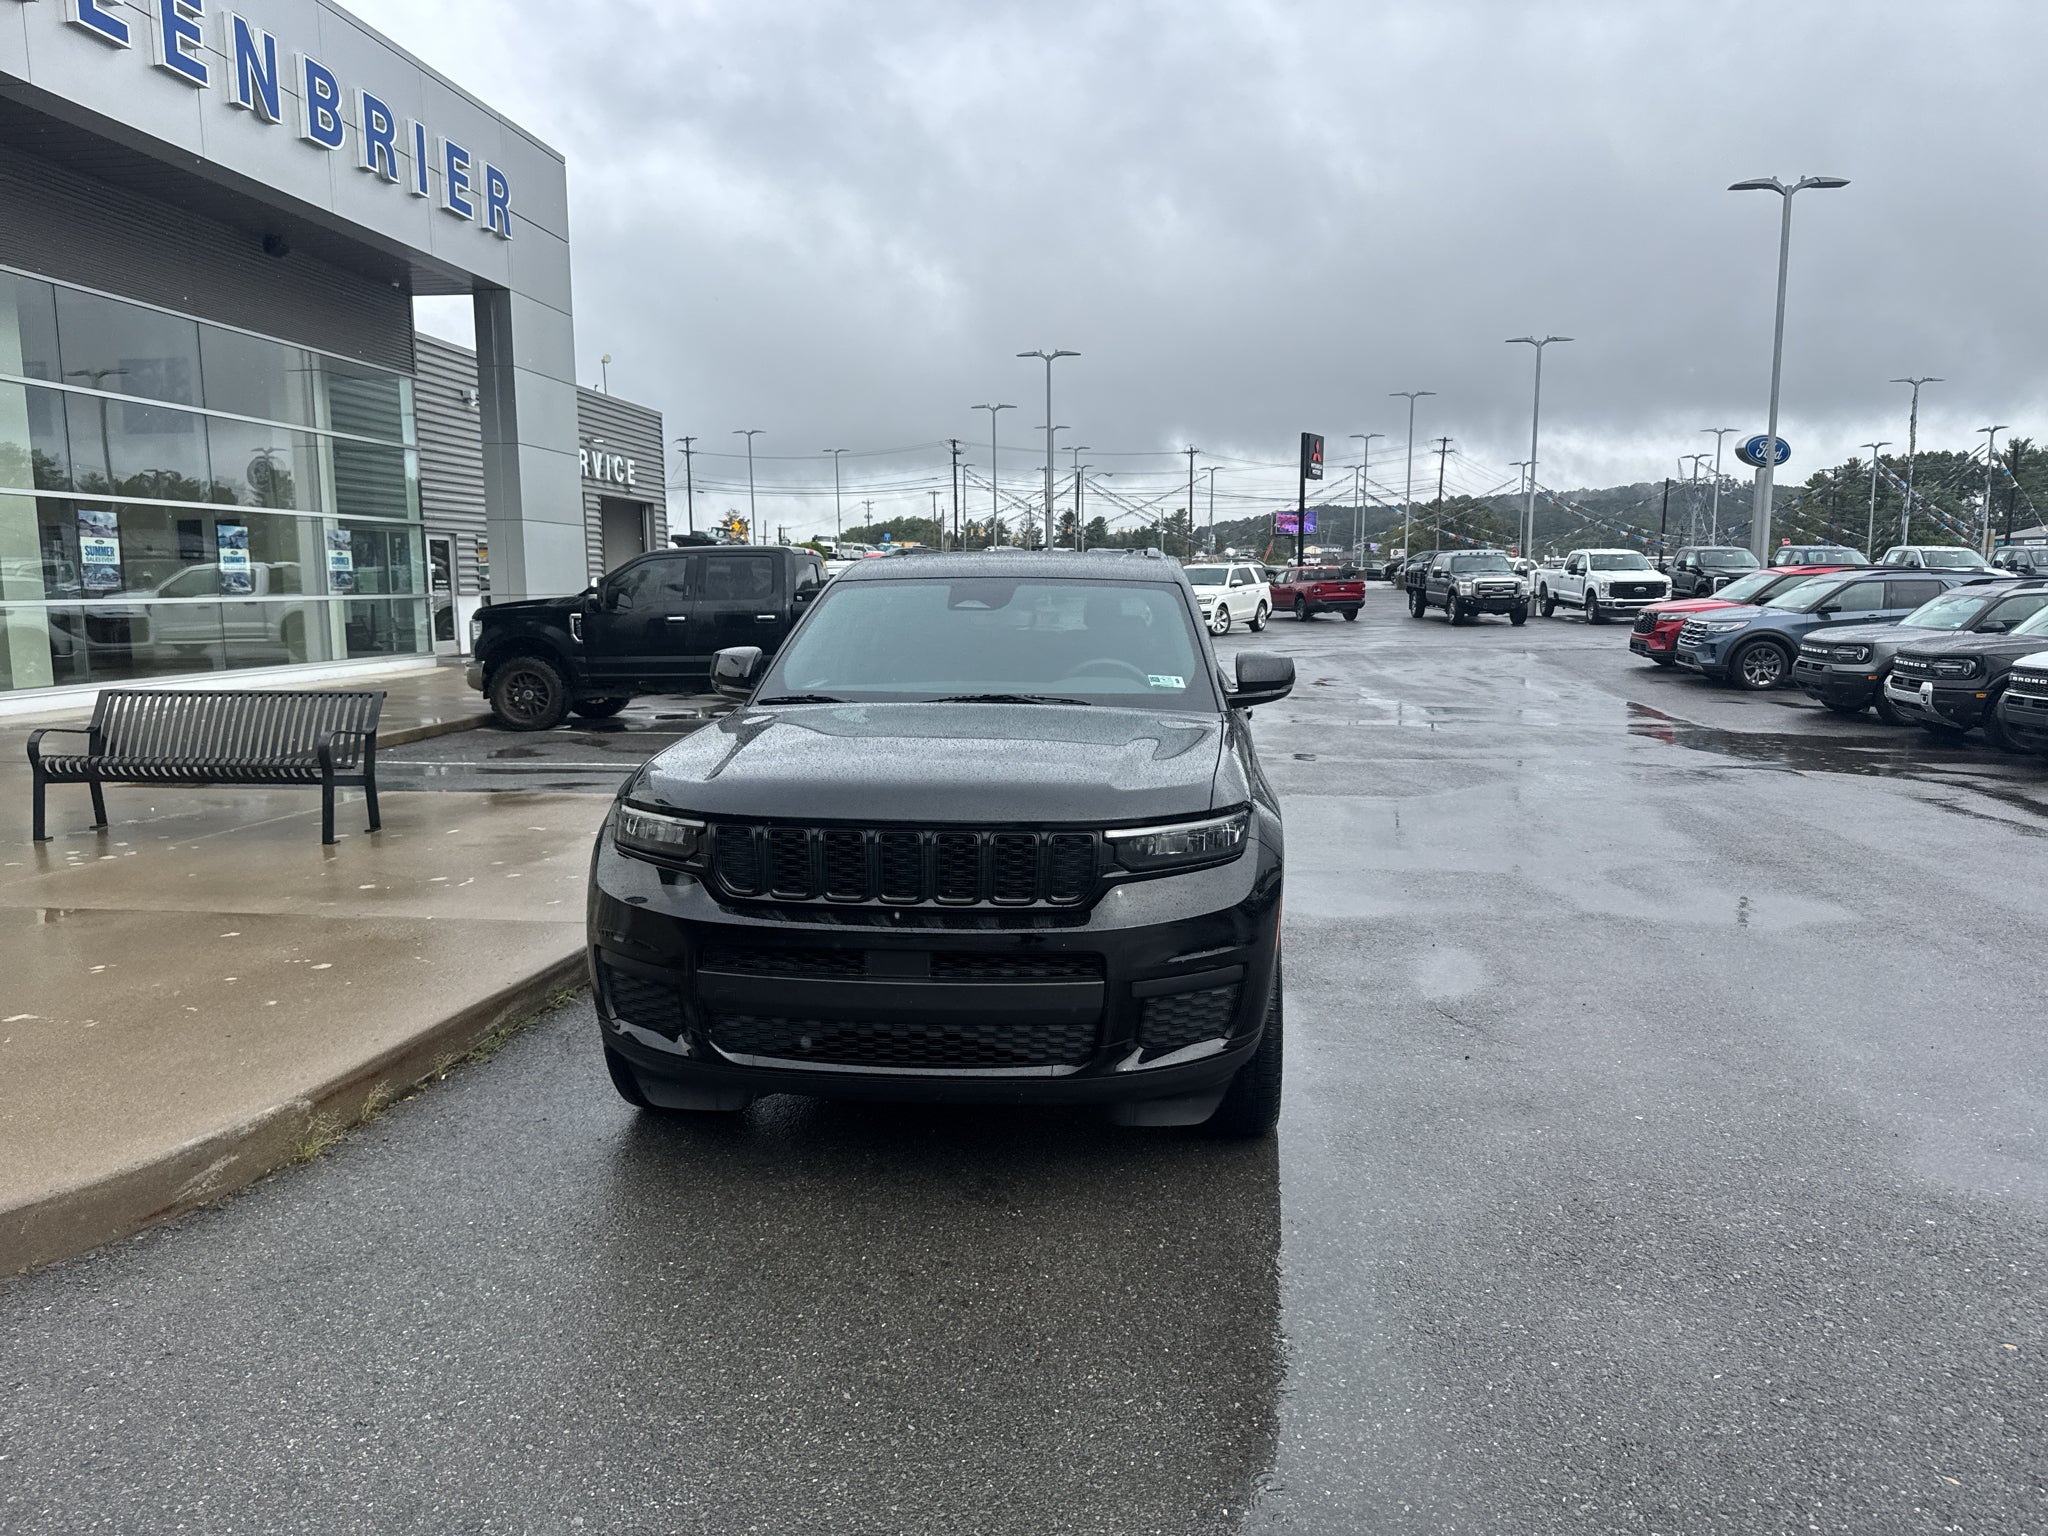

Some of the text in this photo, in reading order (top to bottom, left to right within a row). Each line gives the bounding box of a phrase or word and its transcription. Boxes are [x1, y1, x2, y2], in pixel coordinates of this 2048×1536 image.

[84, 545, 115, 557] SUMMER
[1801, 646, 1828, 655] BRONCO
[1895, 659, 1927, 668] BRONCO
